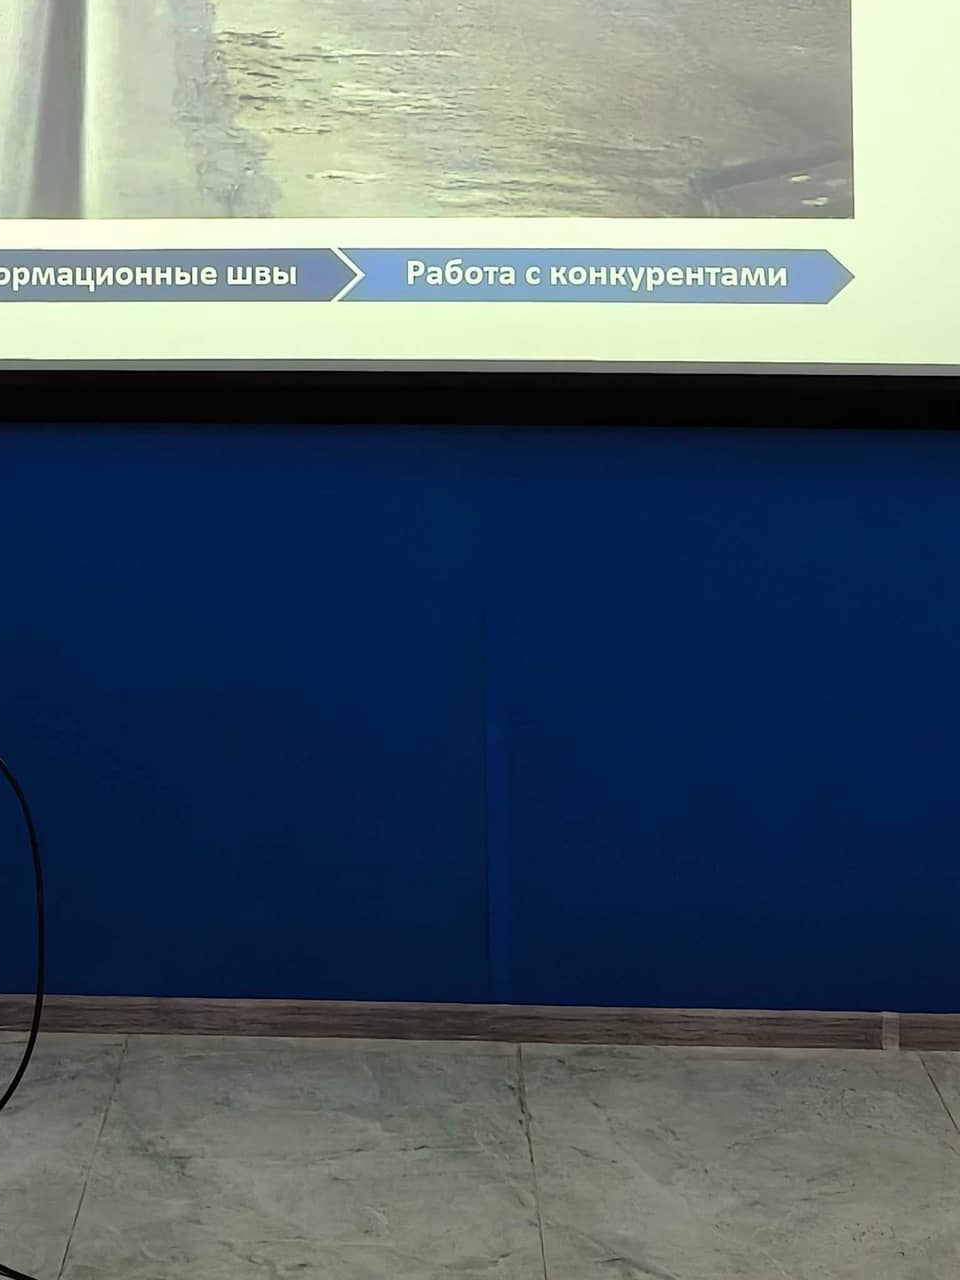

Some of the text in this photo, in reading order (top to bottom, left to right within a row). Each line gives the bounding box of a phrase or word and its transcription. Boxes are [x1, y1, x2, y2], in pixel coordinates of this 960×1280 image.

[227, 265, 298, 287] швы
[406, 260, 789, 293] Работа с конкурентами
